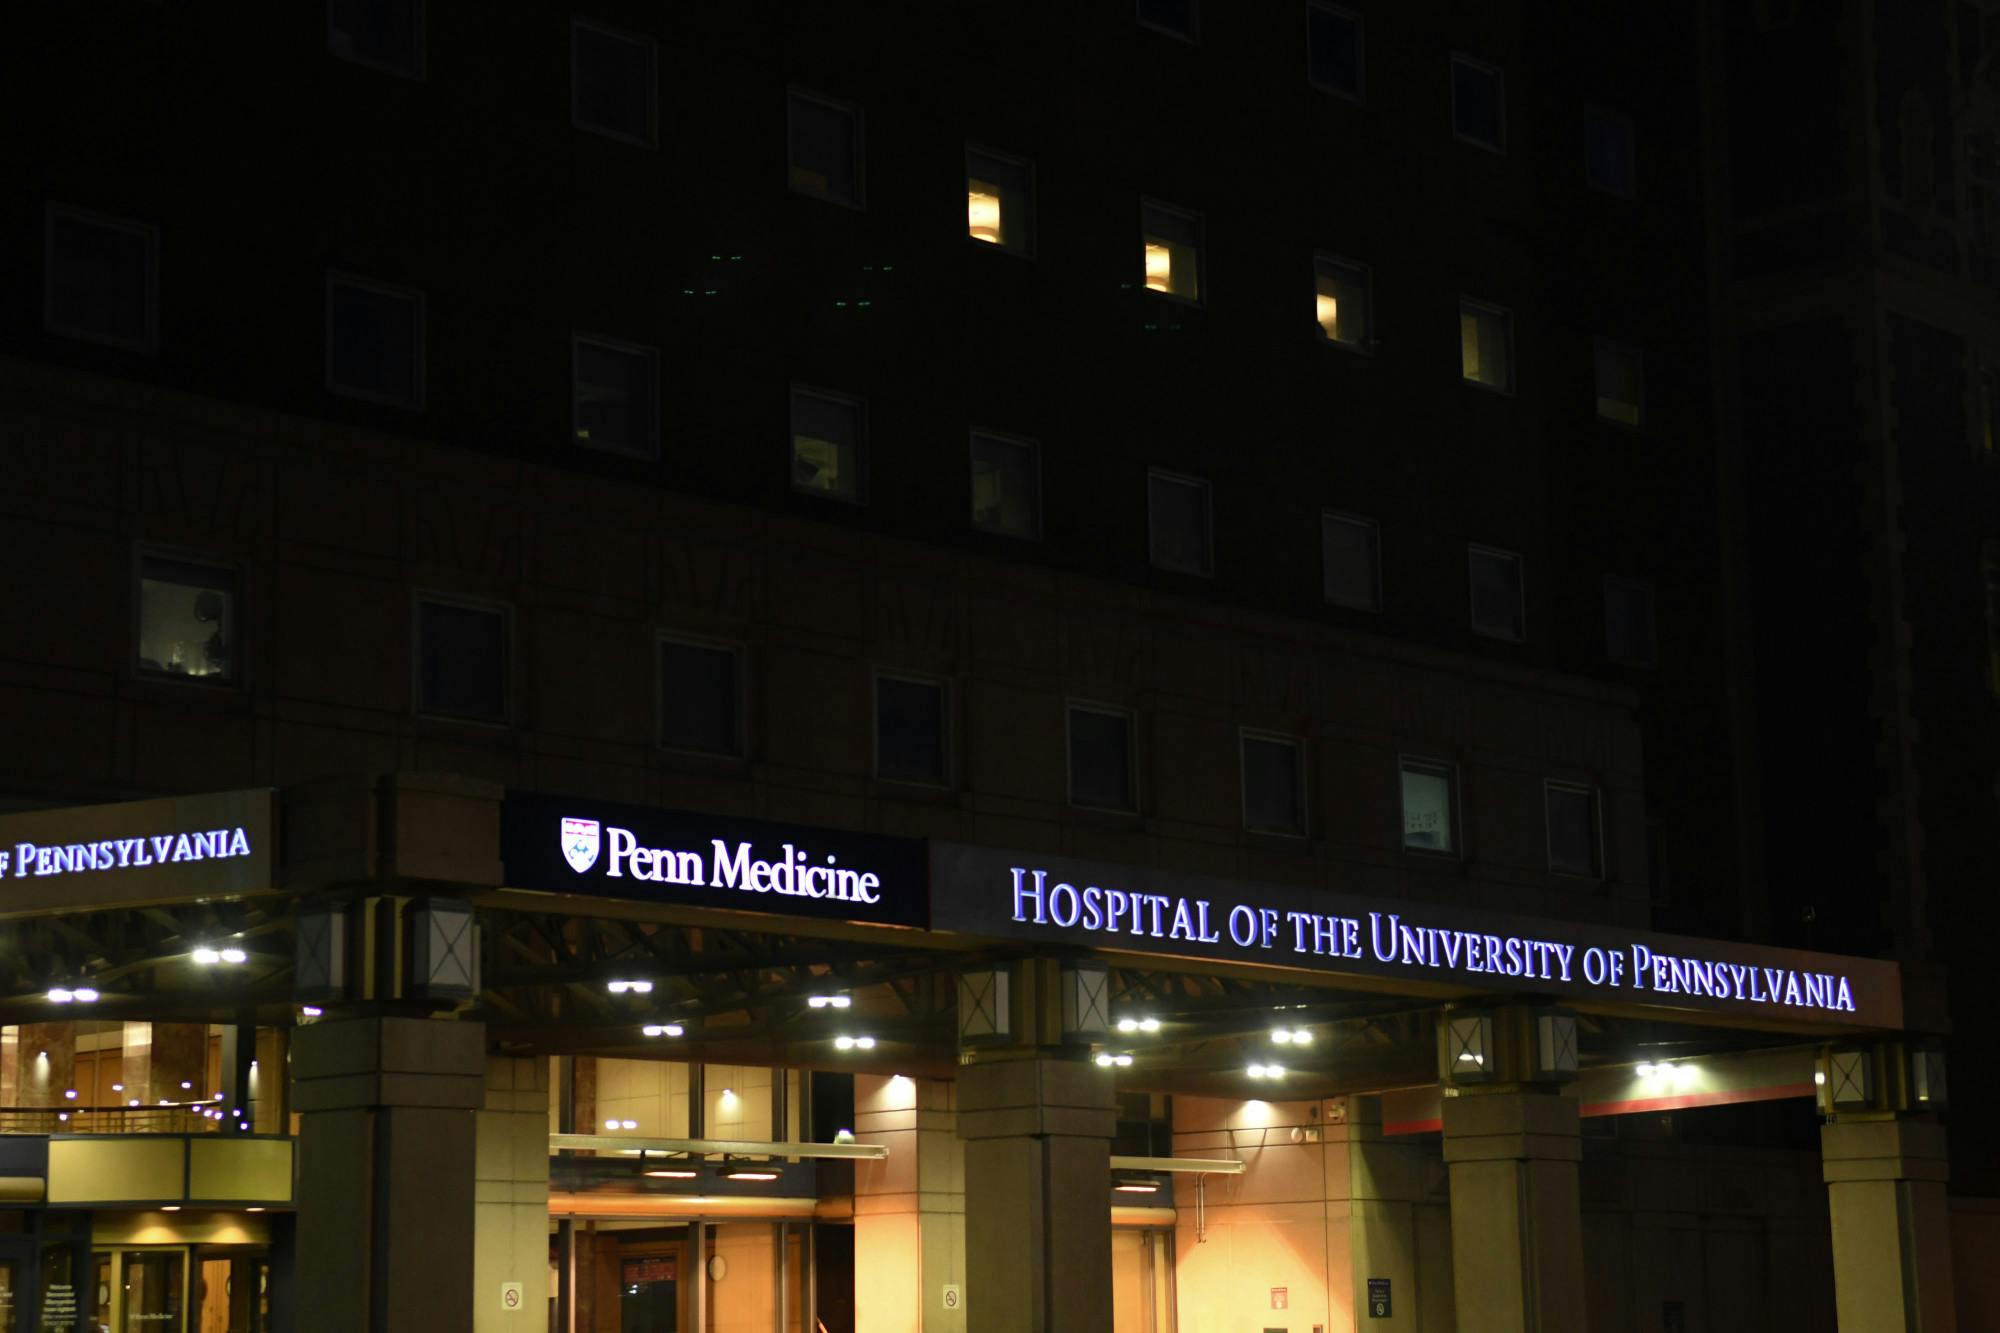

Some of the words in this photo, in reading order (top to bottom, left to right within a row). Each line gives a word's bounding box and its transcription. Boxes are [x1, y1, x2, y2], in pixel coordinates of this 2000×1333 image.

[14, 827, 252, 878] PENNSYLVANIA
[606, 826, 706, 886] Penn
[710, 839, 881, 904] Medicine
[1010, 868, 1220, 943] HOSPITAL
[1229, 905, 1279, 949] OF
[1287, 912, 1363, 958] THE
[1369, 912, 1574, 981] UNIVERSITY
[1583, 948, 1625, 986] OF
[1631, 944, 1857, 1011] PENNSYLVANIA
